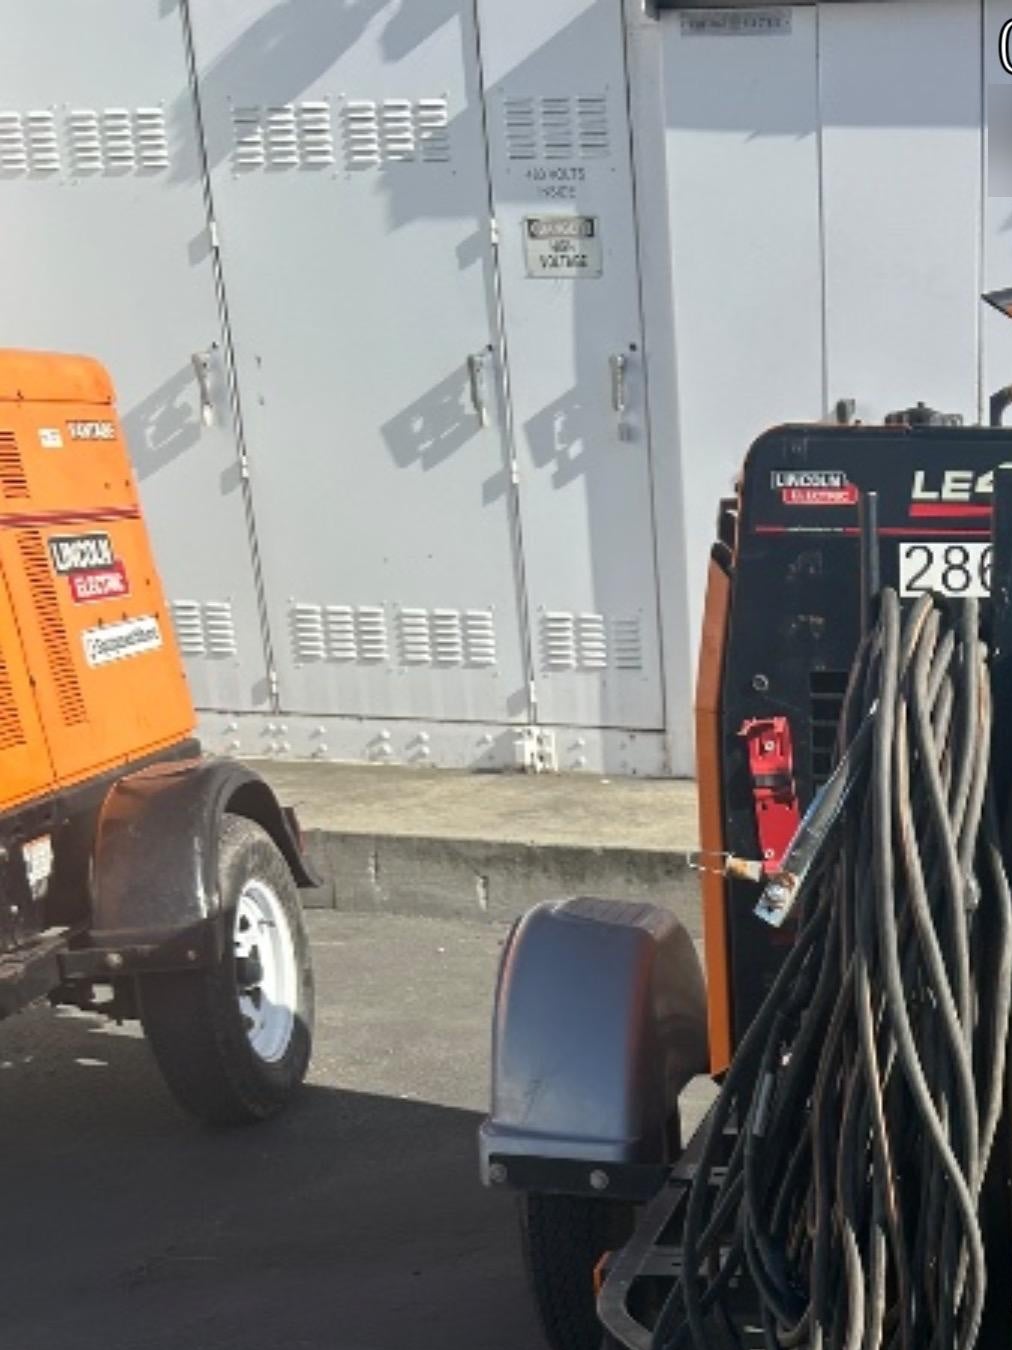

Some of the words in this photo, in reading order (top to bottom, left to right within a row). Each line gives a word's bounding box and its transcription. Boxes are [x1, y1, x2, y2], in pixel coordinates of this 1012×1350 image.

[549, 167, 586, 181] VOLTS
[539, 254, 588, 268] VOLTAGE
[776, 472, 842, 487] LINCOLN
[53, 541, 112, 571] LINCOLN
[74, 574, 124, 597] ELECTRIC
